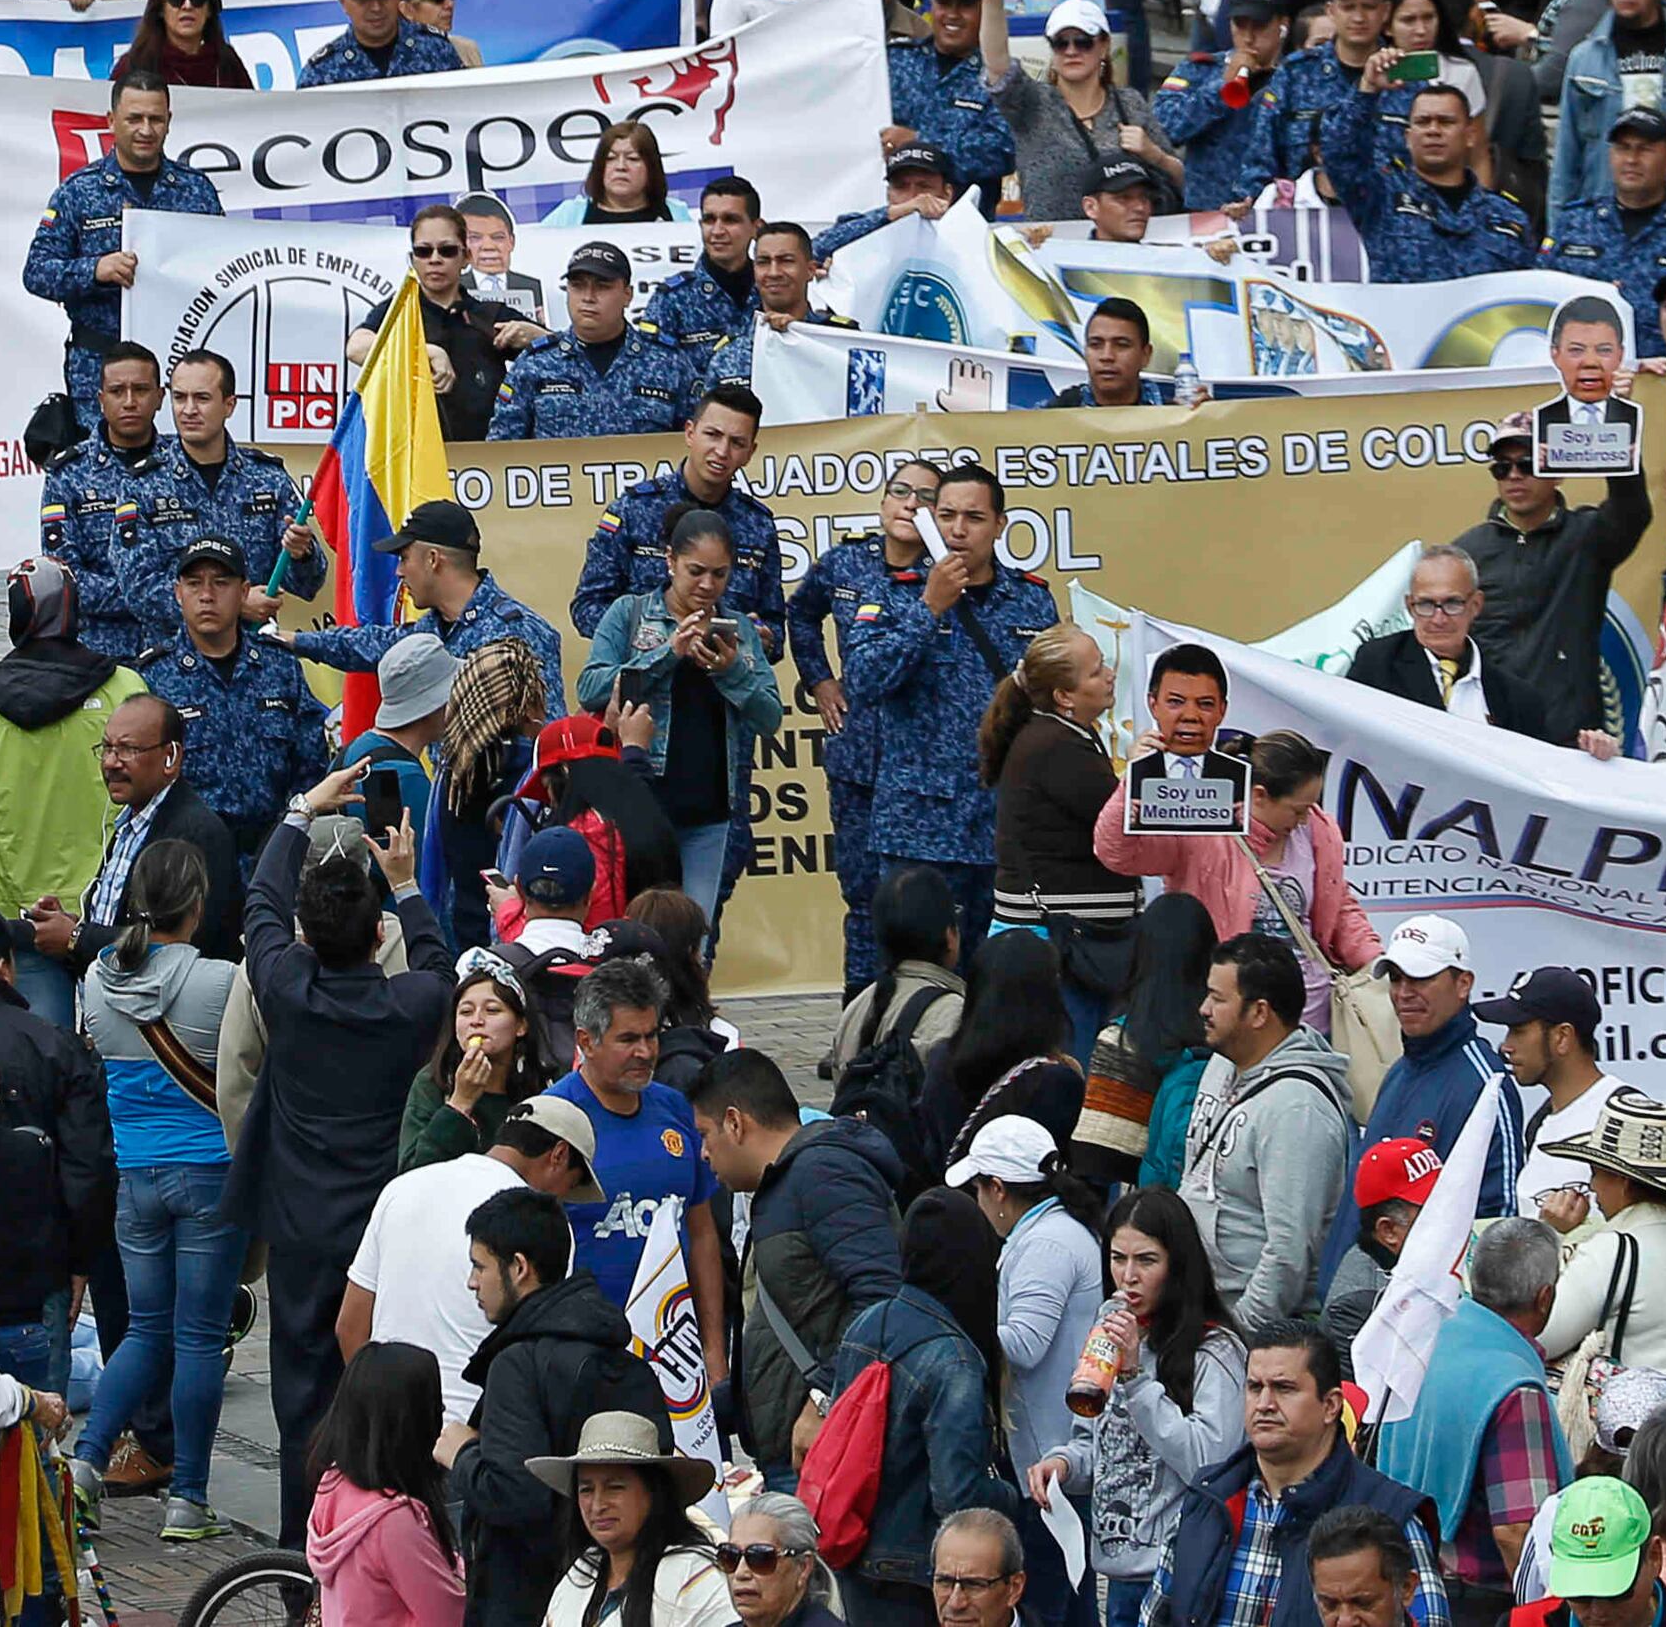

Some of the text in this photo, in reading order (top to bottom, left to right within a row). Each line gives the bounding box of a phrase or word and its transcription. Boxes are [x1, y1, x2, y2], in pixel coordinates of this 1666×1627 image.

[214, 246, 285, 290] SINDICAL
[287, 245, 309, 267] DE
[314, 250, 397, 297] EMPLEAD
[1561, 429, 1594, 449] Soy
[507, 464, 573, 508] DE
[996, 437, 1269, 488] ESTATALES
[1281, 430, 1349, 476] DE
[1361, 418, 1499, 470] COLO
[1550, 447, 1629, 463] Mentiroso
[187, 539, 232, 556] INPEC
[1155, 784, 1218, 804] Soy un
[1142, 802, 1231, 822] Mentiroso
[1476, 855, 1654, 906] NACIONAL
[1348, 876, 1587, 907] NITENCIARIO
